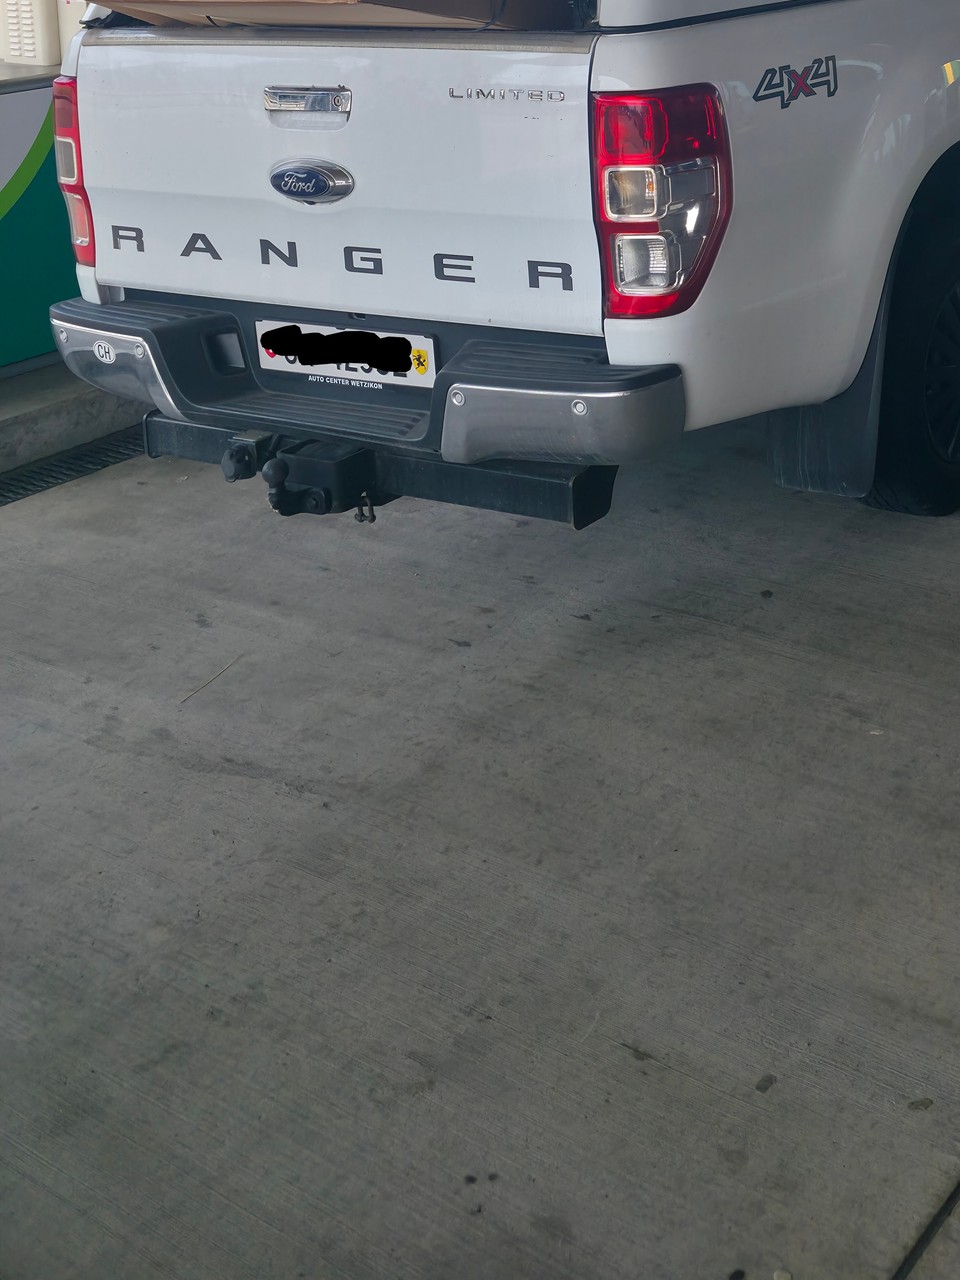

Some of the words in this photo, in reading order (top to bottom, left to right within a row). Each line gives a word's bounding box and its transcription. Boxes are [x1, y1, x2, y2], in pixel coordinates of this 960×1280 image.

[448, 88, 566, 103] LIMITED
[281, 171, 316, 193] Ford
[111, 225, 575, 292] RANGER
[97, 344, 112, 361] CH
[308, 375, 324, 383] AUTO
[325, 376, 350, 385] CENTER
[350, 379, 383, 390] WETZIKON
